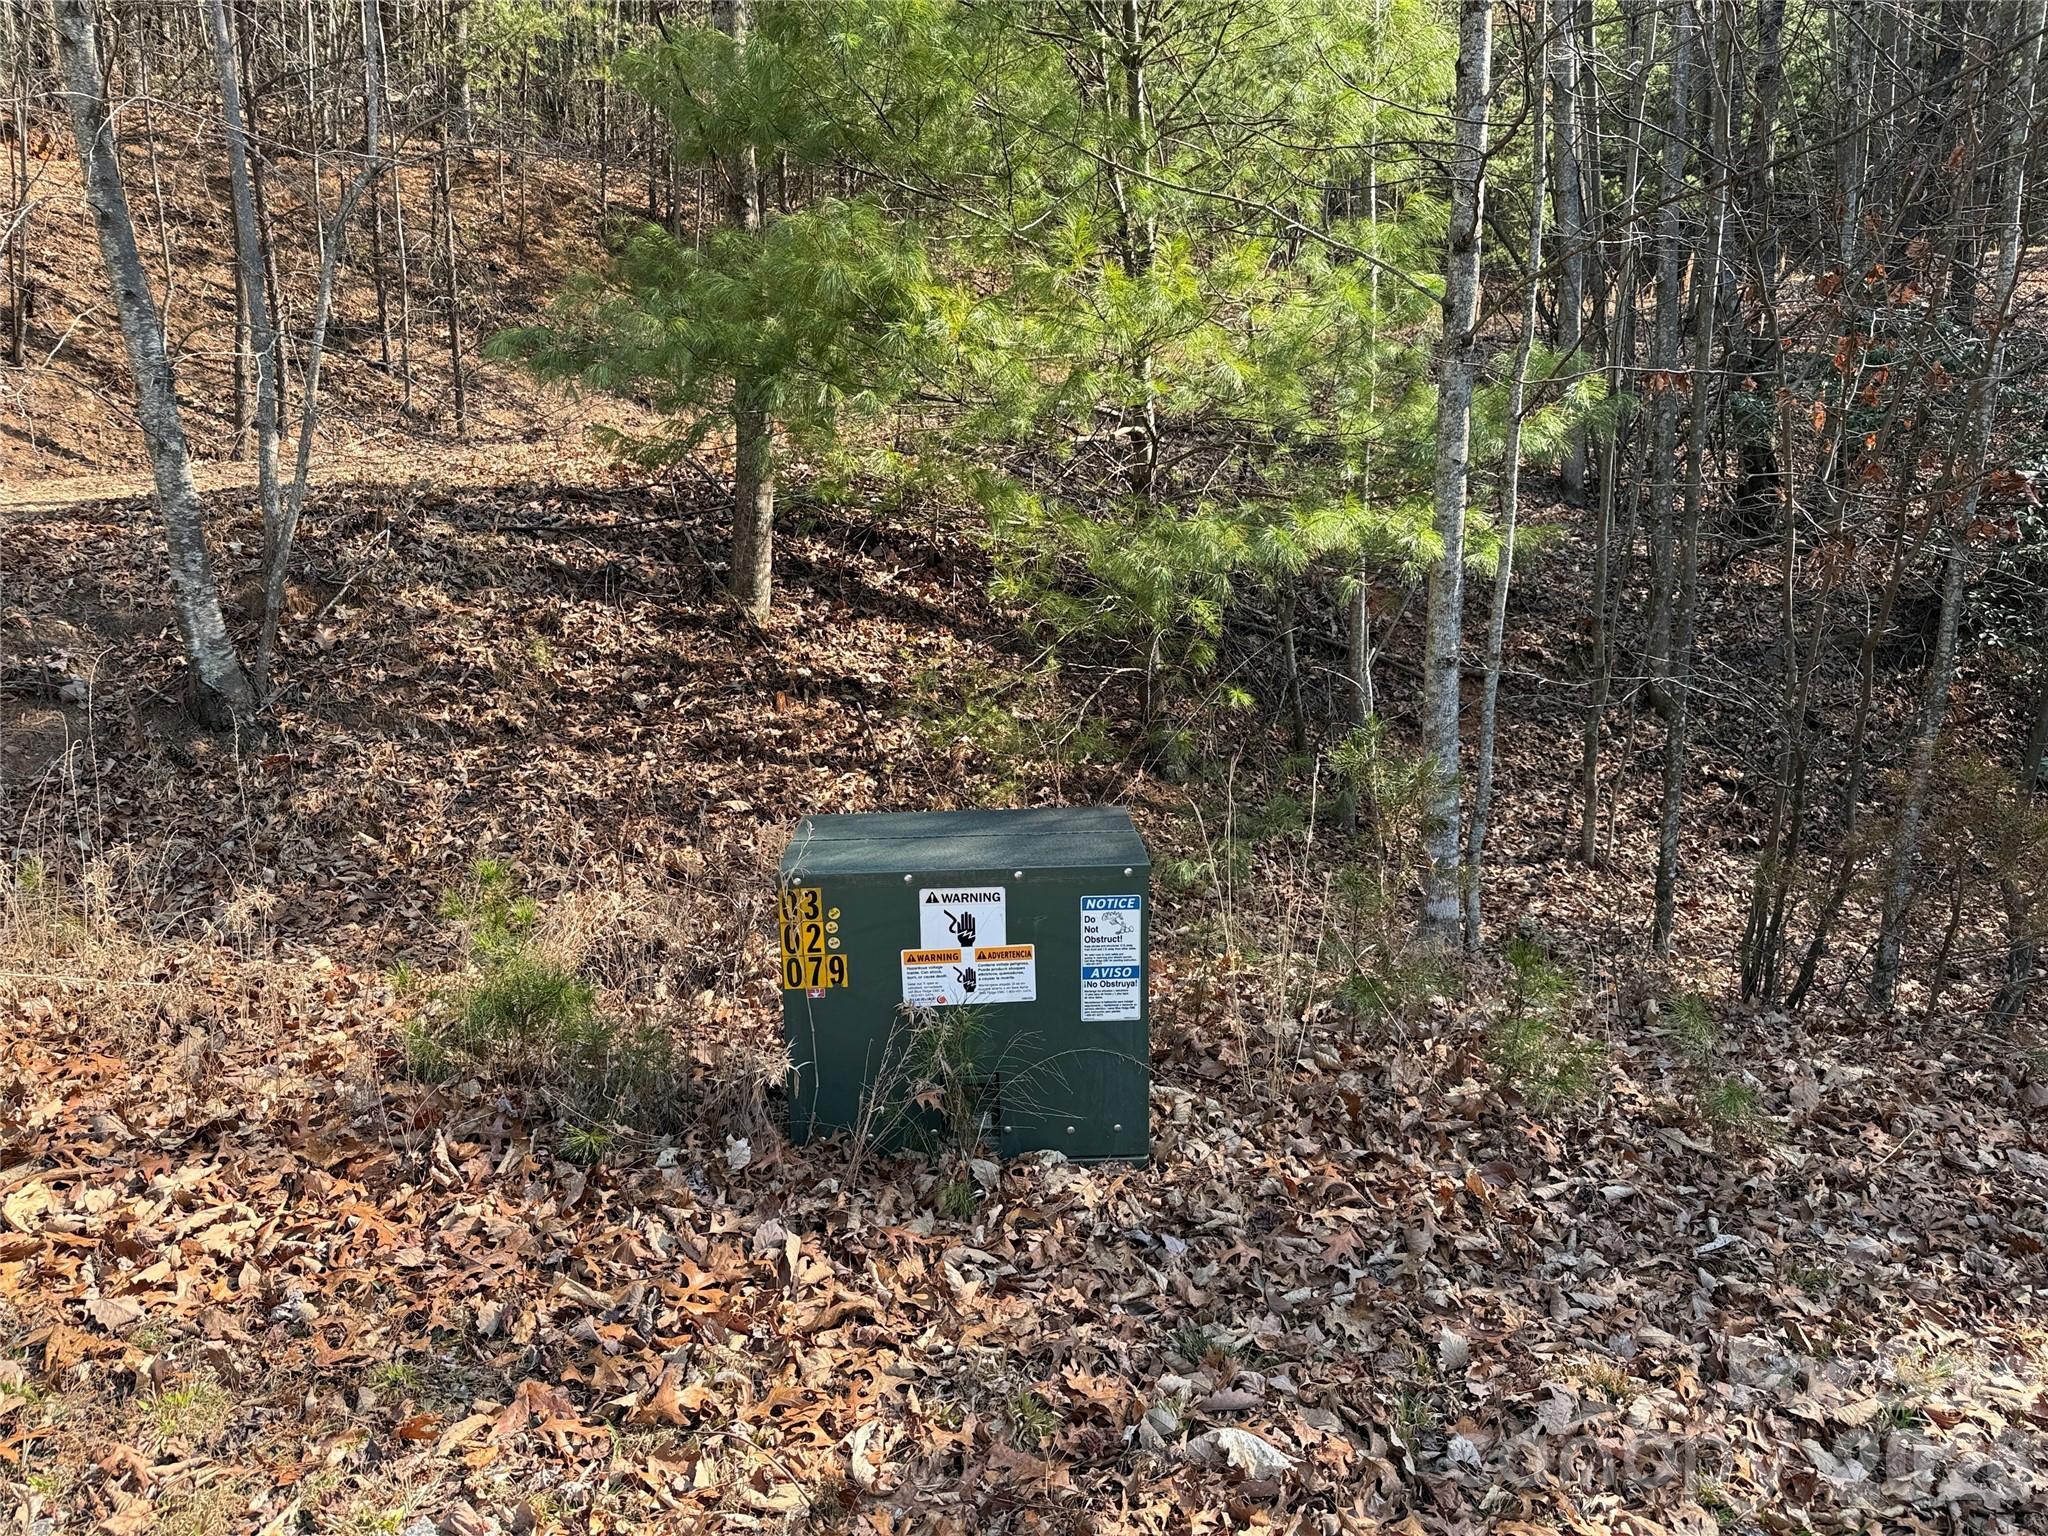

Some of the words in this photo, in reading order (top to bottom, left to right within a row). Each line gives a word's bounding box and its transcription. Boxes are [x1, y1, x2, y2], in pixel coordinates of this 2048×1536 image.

[940, 892, 1001, 904] WARNING
[781, 889, 819, 921] 03
[1086, 898, 1136, 909] NOTICE
[1084, 915, 1096, 924] Do
[1084, 925, 1099, 933] Not
[784, 923, 822, 955] 02
[1084, 935, 1123, 944] Obstruct!
[916, 952, 959, 962] WARNING
[987, 950, 1032, 960] ADVERTENCIA
[786, 956, 845, 988] 079
[1091, 968, 1132, 978] AVISO
[1099, 979, 1138, 989] Obstruya!
